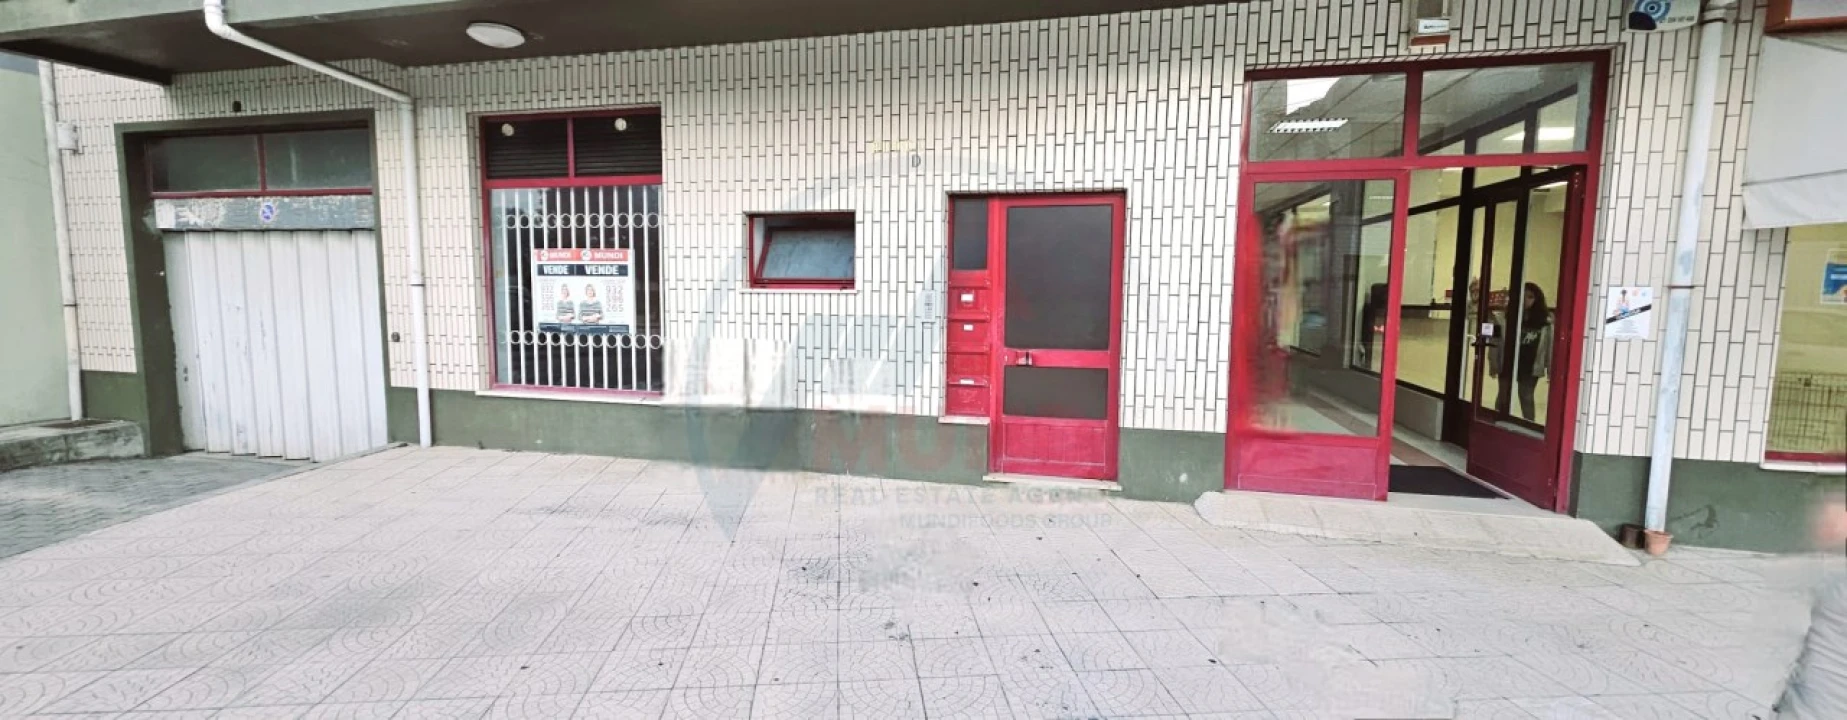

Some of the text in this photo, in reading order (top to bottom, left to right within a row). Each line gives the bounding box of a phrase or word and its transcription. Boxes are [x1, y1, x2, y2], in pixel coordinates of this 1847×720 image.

[594, 251, 623, 259] MUNDI
[543, 264, 569, 275] VENDE
[585, 264, 620, 275] VENDE
[605, 285, 624, 294] 932
[605, 304, 624, 312] 265
